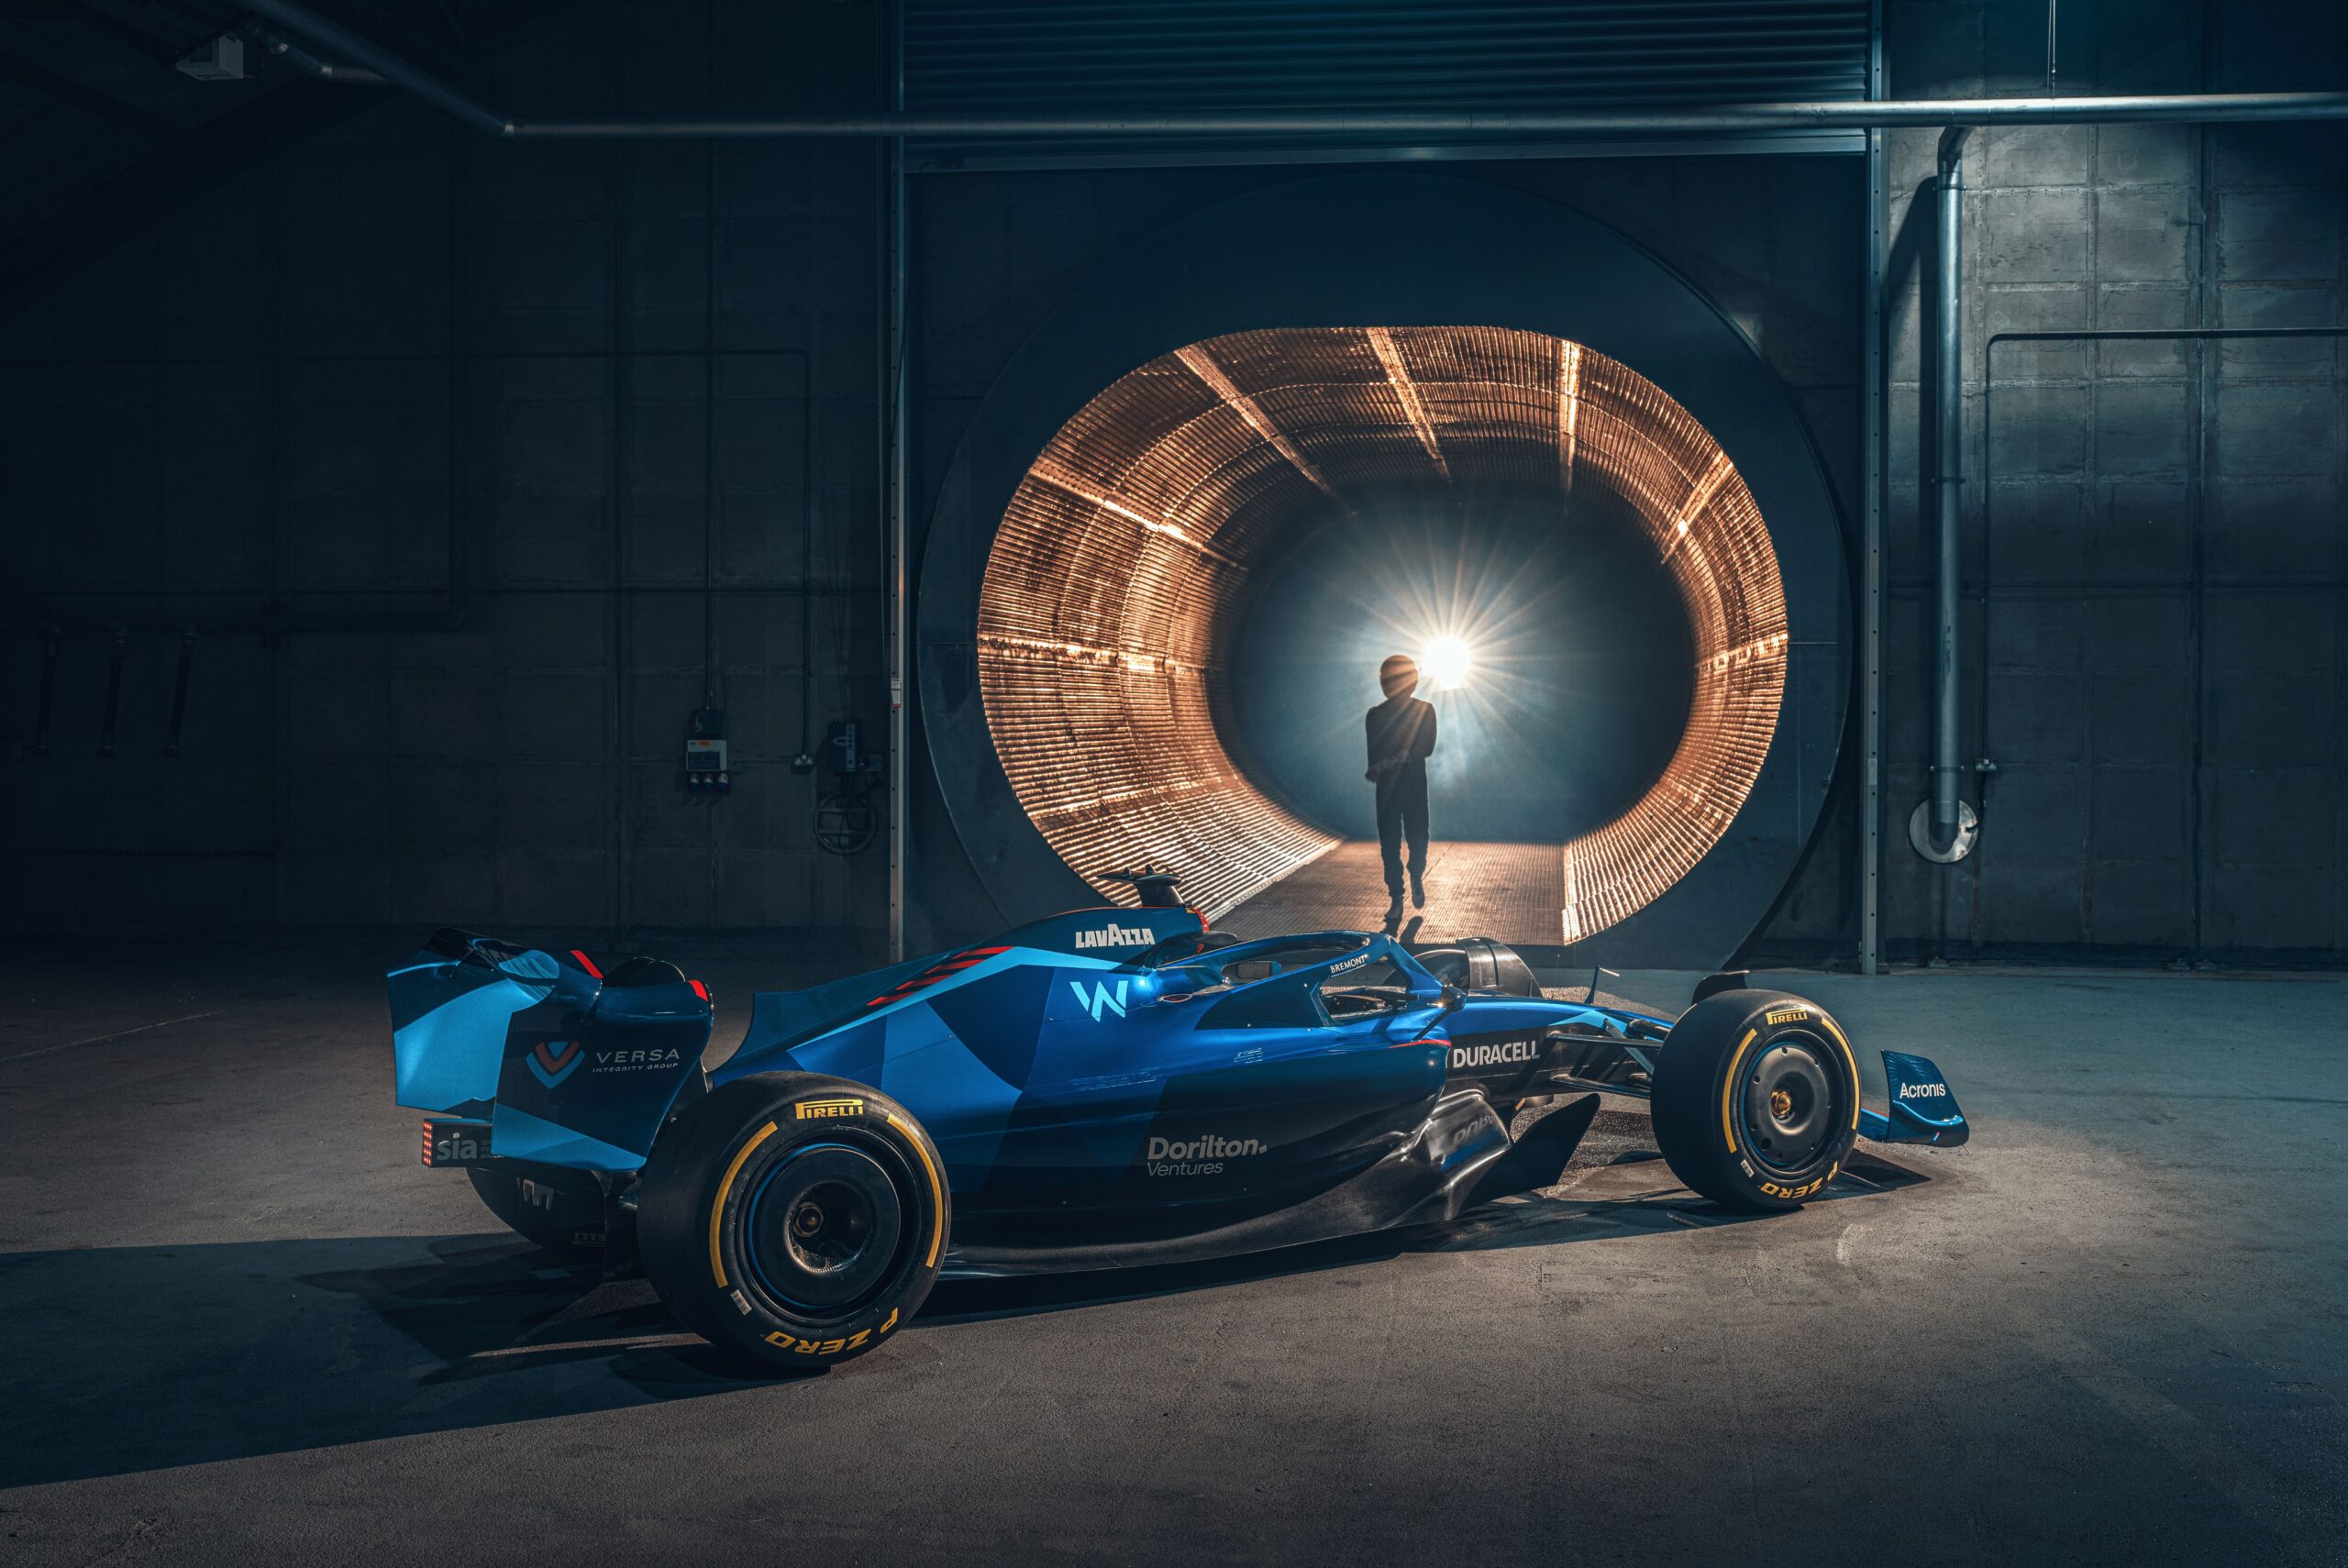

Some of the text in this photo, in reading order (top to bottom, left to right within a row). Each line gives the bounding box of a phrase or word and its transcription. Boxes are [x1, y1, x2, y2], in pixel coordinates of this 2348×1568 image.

[1075, 923, 1156, 949] LAVAZZA
[1330, 955, 1367, 974] BREMONT
[1766, 1008, 1808, 1025] PIRELLI
[596, 1048, 680, 1065] VERSA
[1452, 1040, 1541, 1069] DURACELL
[593, 1062, 679, 1074] INTEGRITY GROUP
[1899, 1082, 1946, 1099] Acronis
[795, 1099, 864, 1121] PIRELLI
[436, 1132, 478, 1161] sia
[1146, 1162, 1224, 1177] Ventures
[1760, 1161, 1839, 1199] P ZERO
[764, 1307, 899, 1356] P ZERO
